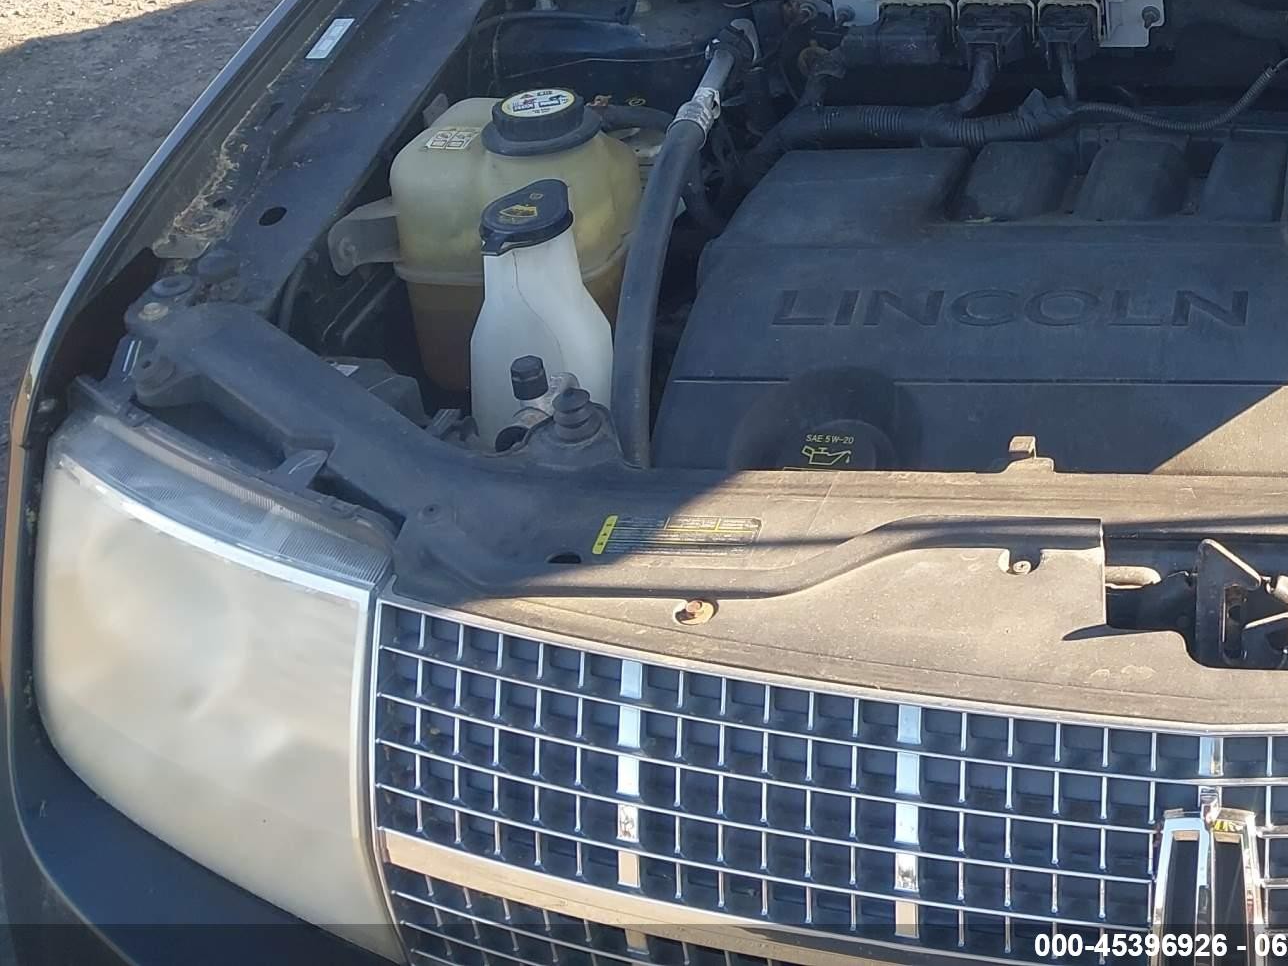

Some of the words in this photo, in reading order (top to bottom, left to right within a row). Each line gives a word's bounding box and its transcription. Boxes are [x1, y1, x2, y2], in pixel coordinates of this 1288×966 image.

[772, 287, 1249, 327] LINCOLN
[805, 434, 824, 443] SAE
[825, 435, 855, 444] 5W-20
